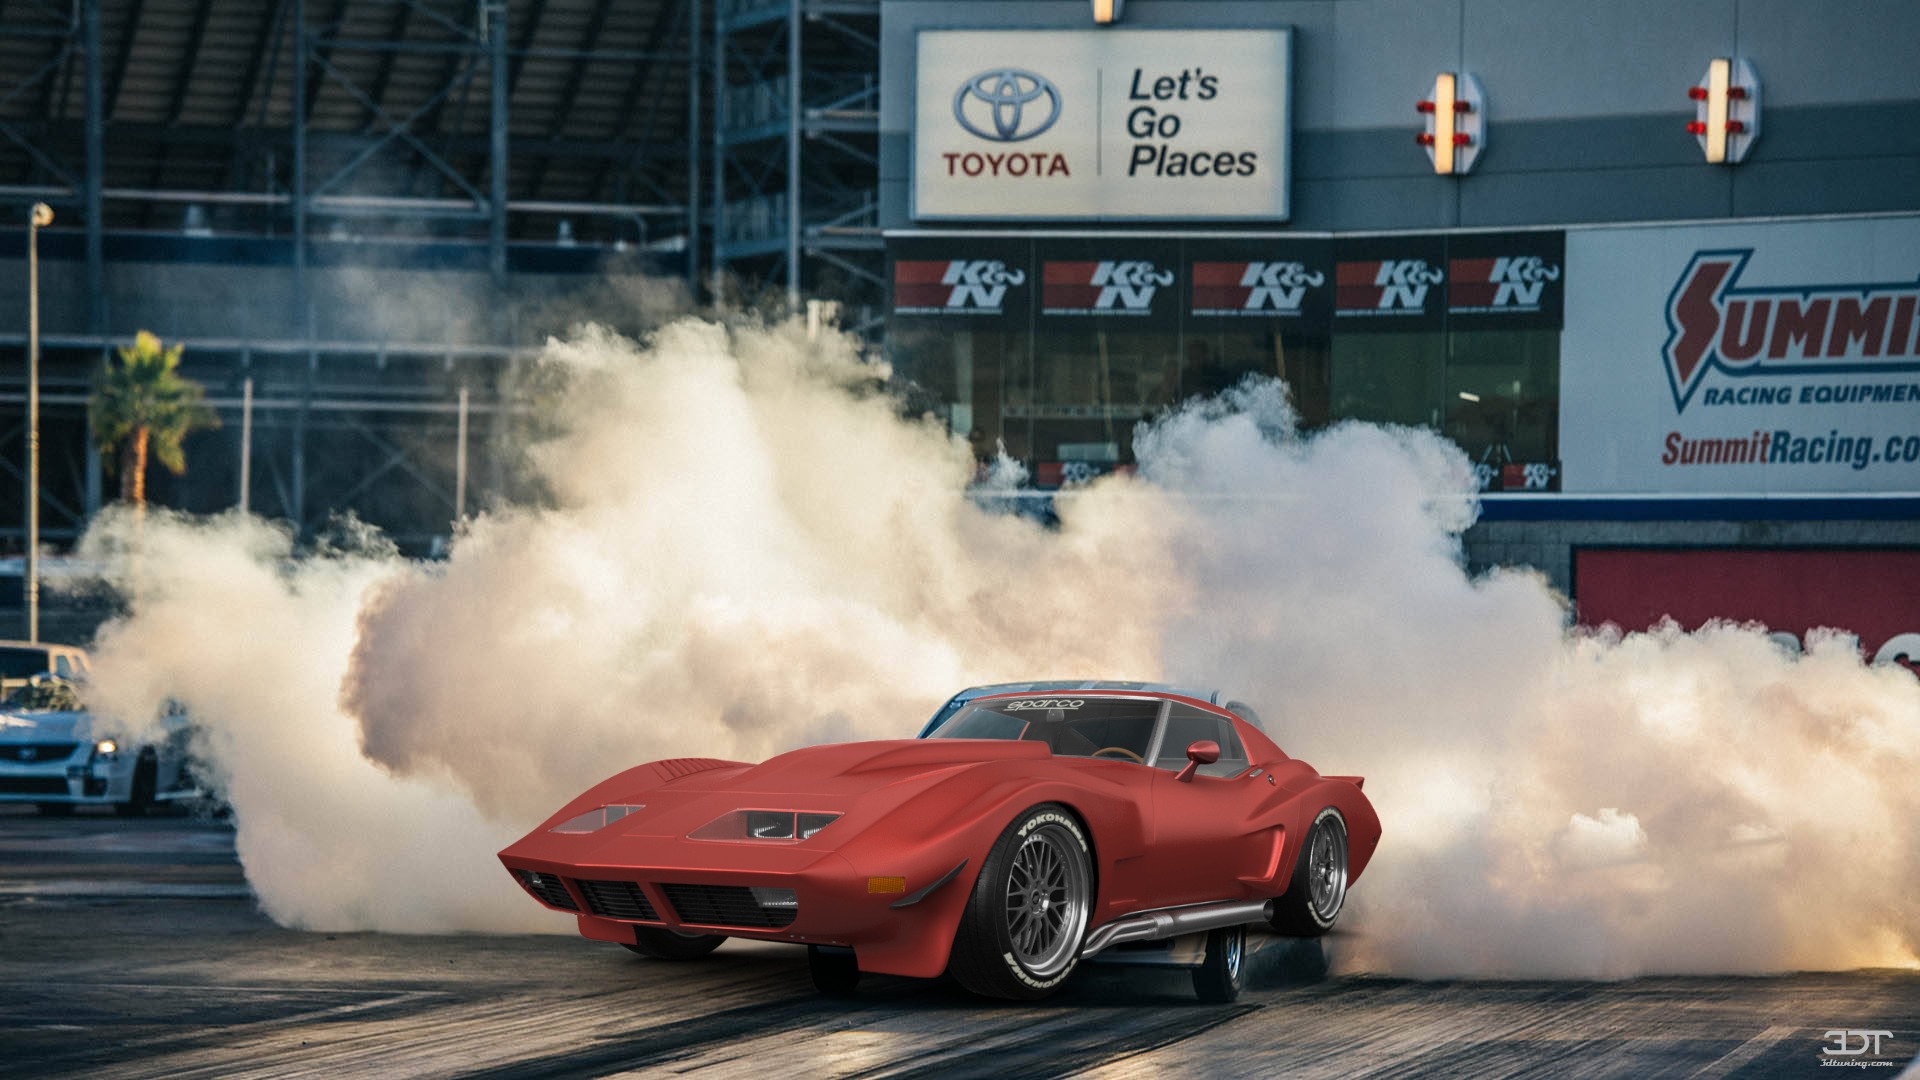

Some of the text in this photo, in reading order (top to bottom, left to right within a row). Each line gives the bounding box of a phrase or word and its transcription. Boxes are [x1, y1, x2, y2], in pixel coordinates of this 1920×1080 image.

[1129, 67, 1218, 100] Let's
[1127, 106, 1181, 138] Go
[943, 153, 1070, 177] TOYOTA
[1128, 144, 1257, 177] Places
[941, 260, 1025, 307] K&N
[1089, 261, 1175, 308] K&N
[1241, 262, 1325, 309] K&N
[1374, 260, 1444, 309] K&N
[1488, 256, 1560, 306] K&N
[1664, 249, 1920, 408] SUMMI
[1703, 387, 1792, 406] RACING
[1662, 430, 1920, 470] SummitRacing.co
[1006, 699, 1085, 712] sparco
[1018, 813, 1087, 852] YOKOHAMA
